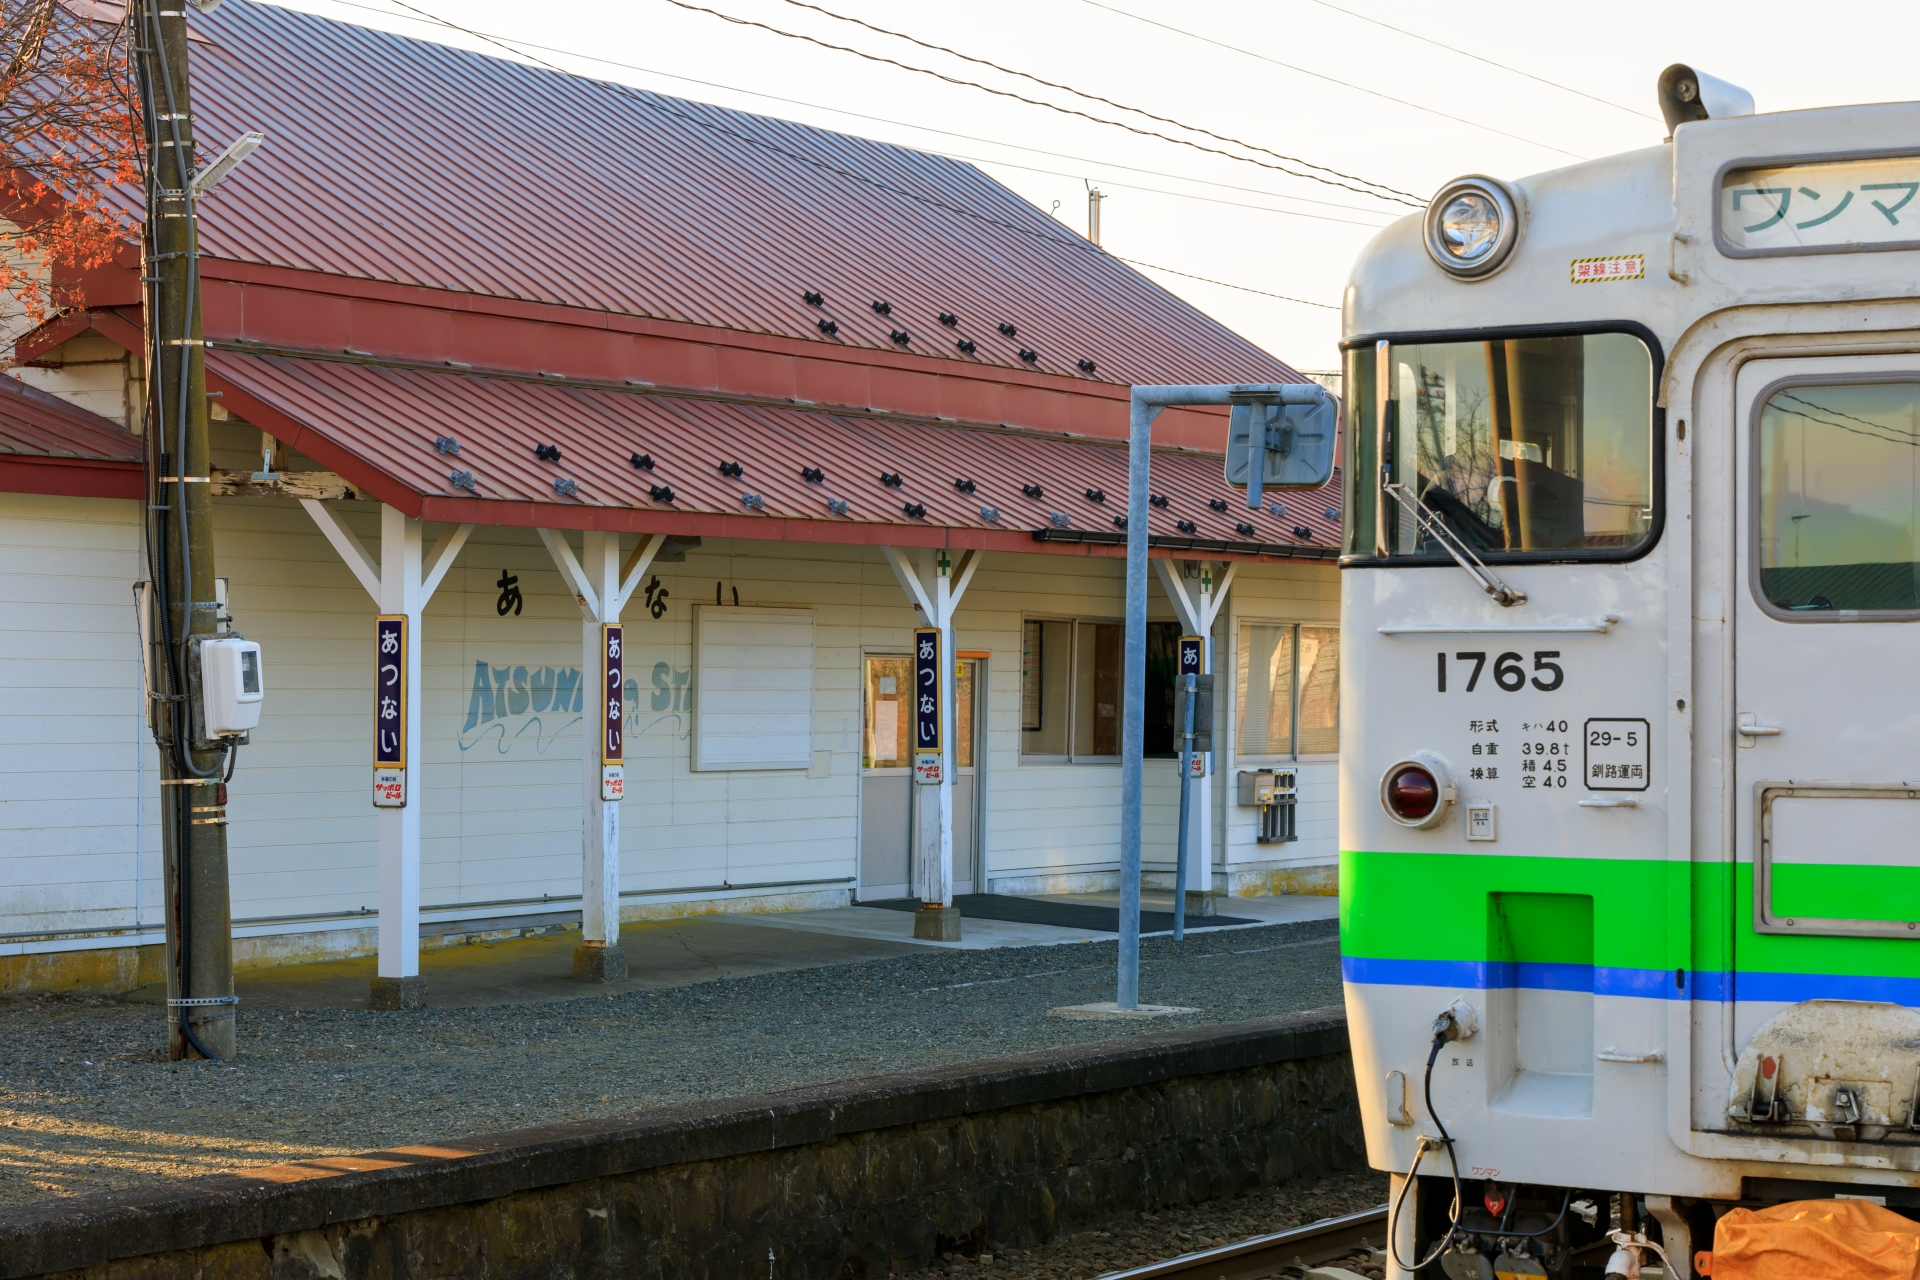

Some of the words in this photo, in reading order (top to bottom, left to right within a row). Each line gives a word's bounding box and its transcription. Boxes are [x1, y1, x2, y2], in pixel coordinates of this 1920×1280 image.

[1733, 182, 1920, 233] ワンマ
[1578, 260, 1637, 277] 架線注意
[1437, 651, 1564, 692] 1765
[381, 630, 399, 753] あつない
[608, 636, 621, 751] あつない
[919, 640, 936, 741] あつない
[1470, 719, 1499, 733] 形式
[1472, 743, 1499, 755] 自重
[1522, 743, 1569, 755] 39.8t
[1522, 759, 1536, 772] 積
[1543, 759, 1567, 772] 4.5
[1592, 764, 1643, 779] 釧路運両
[1470, 767, 1499, 780] 換算
[375, 783, 402, 791] サッポロ
[1522, 775, 1536, 788] 空
[1543, 776, 1567, 788] 4.0
[385, 791, 402, 799] ビール
[1471, 1167, 1501, 1177] ワンマン
